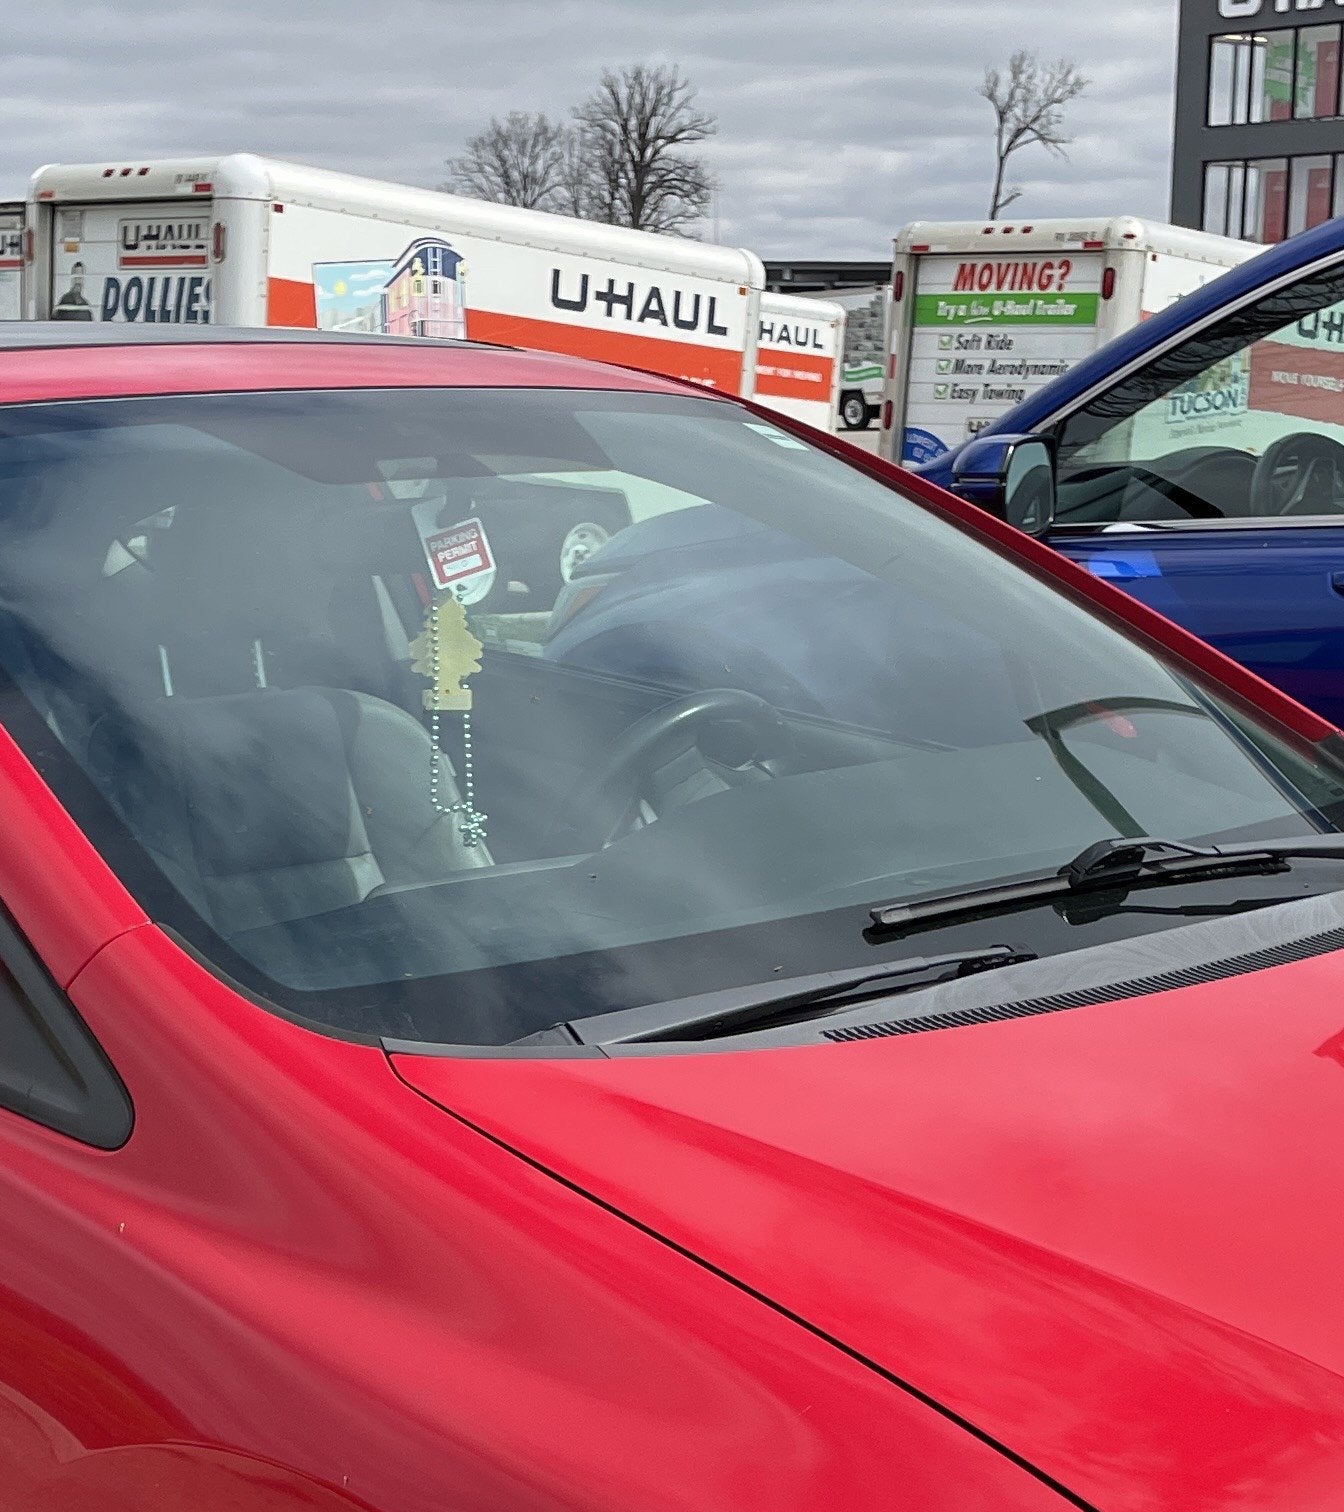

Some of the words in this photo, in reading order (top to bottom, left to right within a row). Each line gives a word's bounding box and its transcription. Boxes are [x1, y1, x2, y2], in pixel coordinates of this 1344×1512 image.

[953, 259, 1071, 292] MOVING?
[551, 268, 728, 337] U-HAUL
[954, 333, 982, 351] Soft
[984, 333, 1014, 351] Ride
[952, 359, 984, 376] More
[950, 383, 979, 404] Easy
[982, 383, 1026, 404] Towing
[1168, 388, 1239, 416] TUCSON
[431, 528, 479, 552] PARKING
[437, 540, 478, 563] PERMIT
